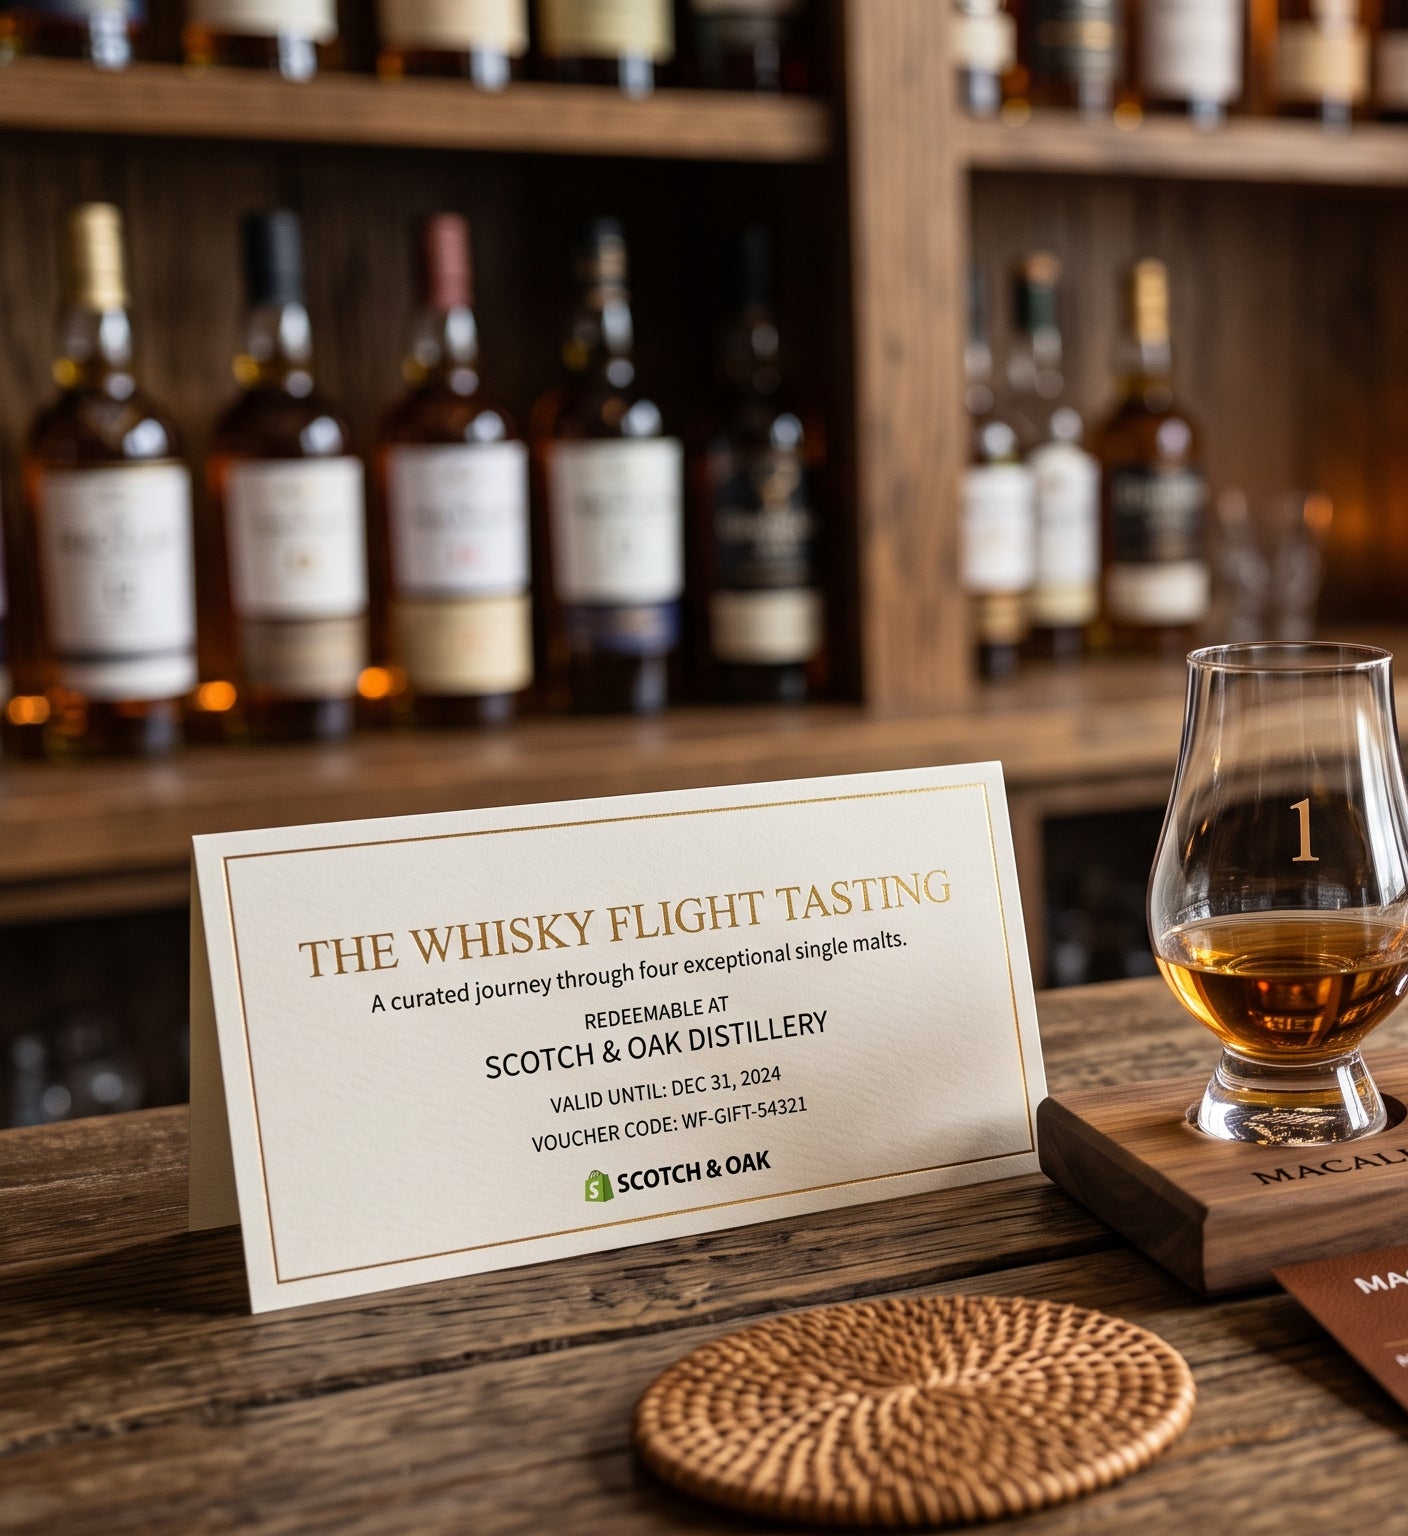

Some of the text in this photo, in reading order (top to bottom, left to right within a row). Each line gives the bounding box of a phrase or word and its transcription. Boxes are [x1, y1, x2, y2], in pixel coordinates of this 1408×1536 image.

[1290, 798, 1320, 862] 1
[298, 869, 950, 977] THE WHISKY FLIGHT TASTING
[371, 930, 906, 1013] A curated journey through four exceptional single malts.
[584, 995, 728, 1029] REDEEMABLE AT
[485, 1009, 828, 1079] SCOTCH & OAK DISTILLERY
[549, 1065, 781, 1113] VALID UNTIL: DEC 31, 2024
[531, 1096, 807, 1152] VOUCHER CODE: WF-GIFT-54321
[617, 1149, 771, 1193] SCOTCH & OAK
